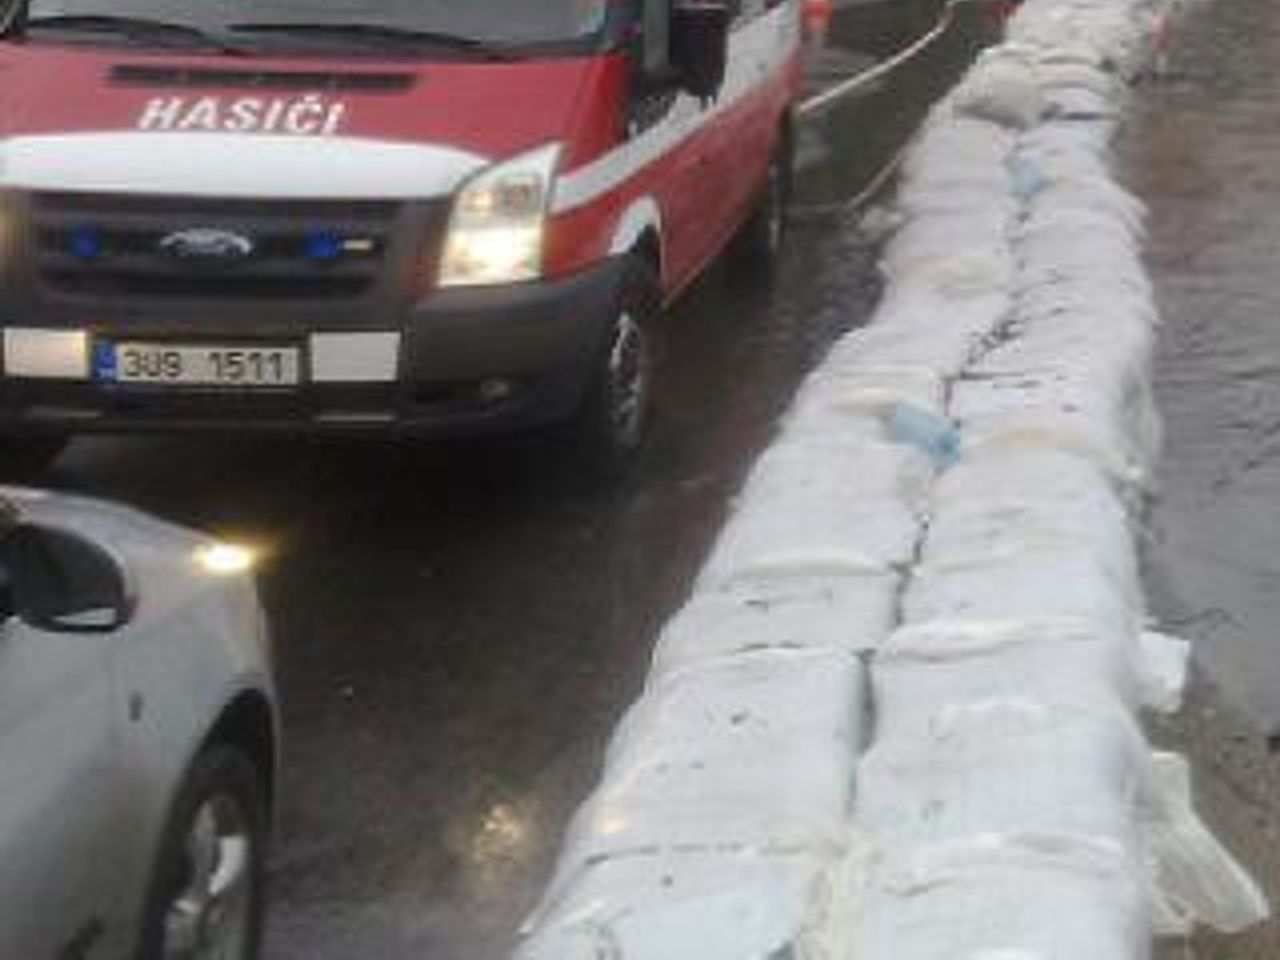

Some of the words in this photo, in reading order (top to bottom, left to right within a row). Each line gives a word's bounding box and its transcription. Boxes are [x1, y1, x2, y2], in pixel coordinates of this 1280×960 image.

[137, 93, 345, 135] HASIČI
[123, 350, 182, 378] 3U9
[209, 351, 284, 382] 1511
